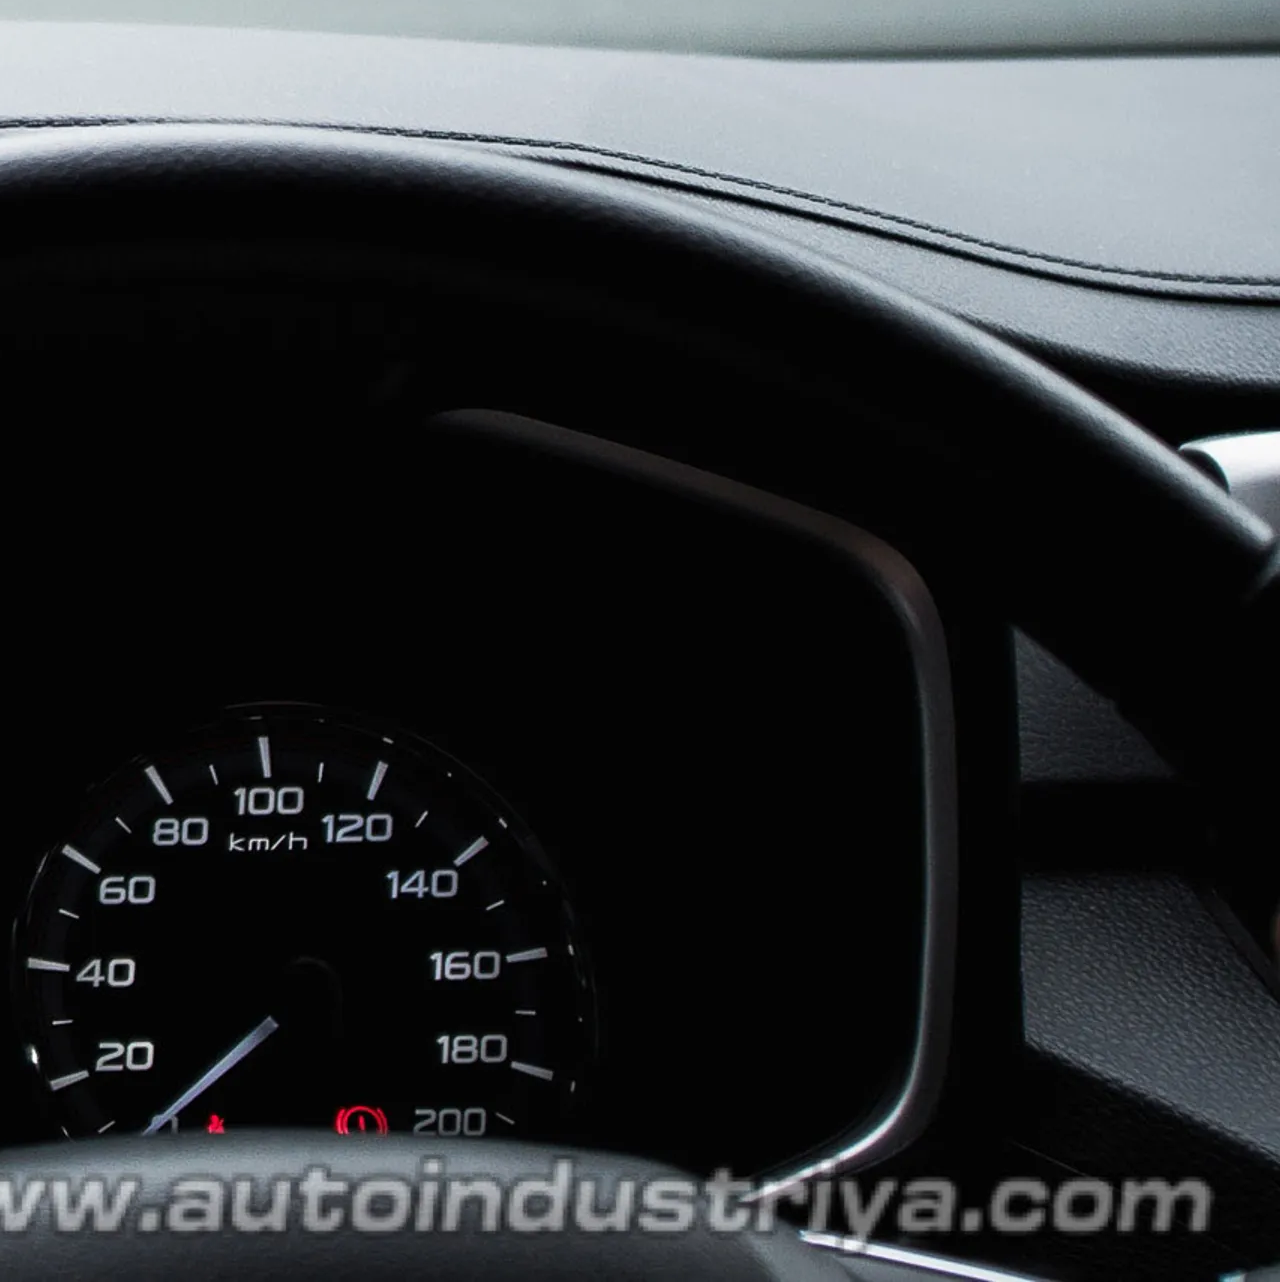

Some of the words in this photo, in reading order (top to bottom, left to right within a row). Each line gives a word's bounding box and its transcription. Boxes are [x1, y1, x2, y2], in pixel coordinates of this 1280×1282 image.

[233, 786, 304, 816] 100
[152, 818, 209, 846] 80
[228, 832, 308, 853] km/h
[321, 813, 393, 843] 120
[99, 875, 156, 905] 60
[386, 869, 458, 899] 140
[76, 958, 136, 988] 40
[429, 951, 500, 981] 160
[95, 1041, 155, 1071] 20
[436, 1034, 508, 1064] 180
[412, 1108, 487, 1138] 200
